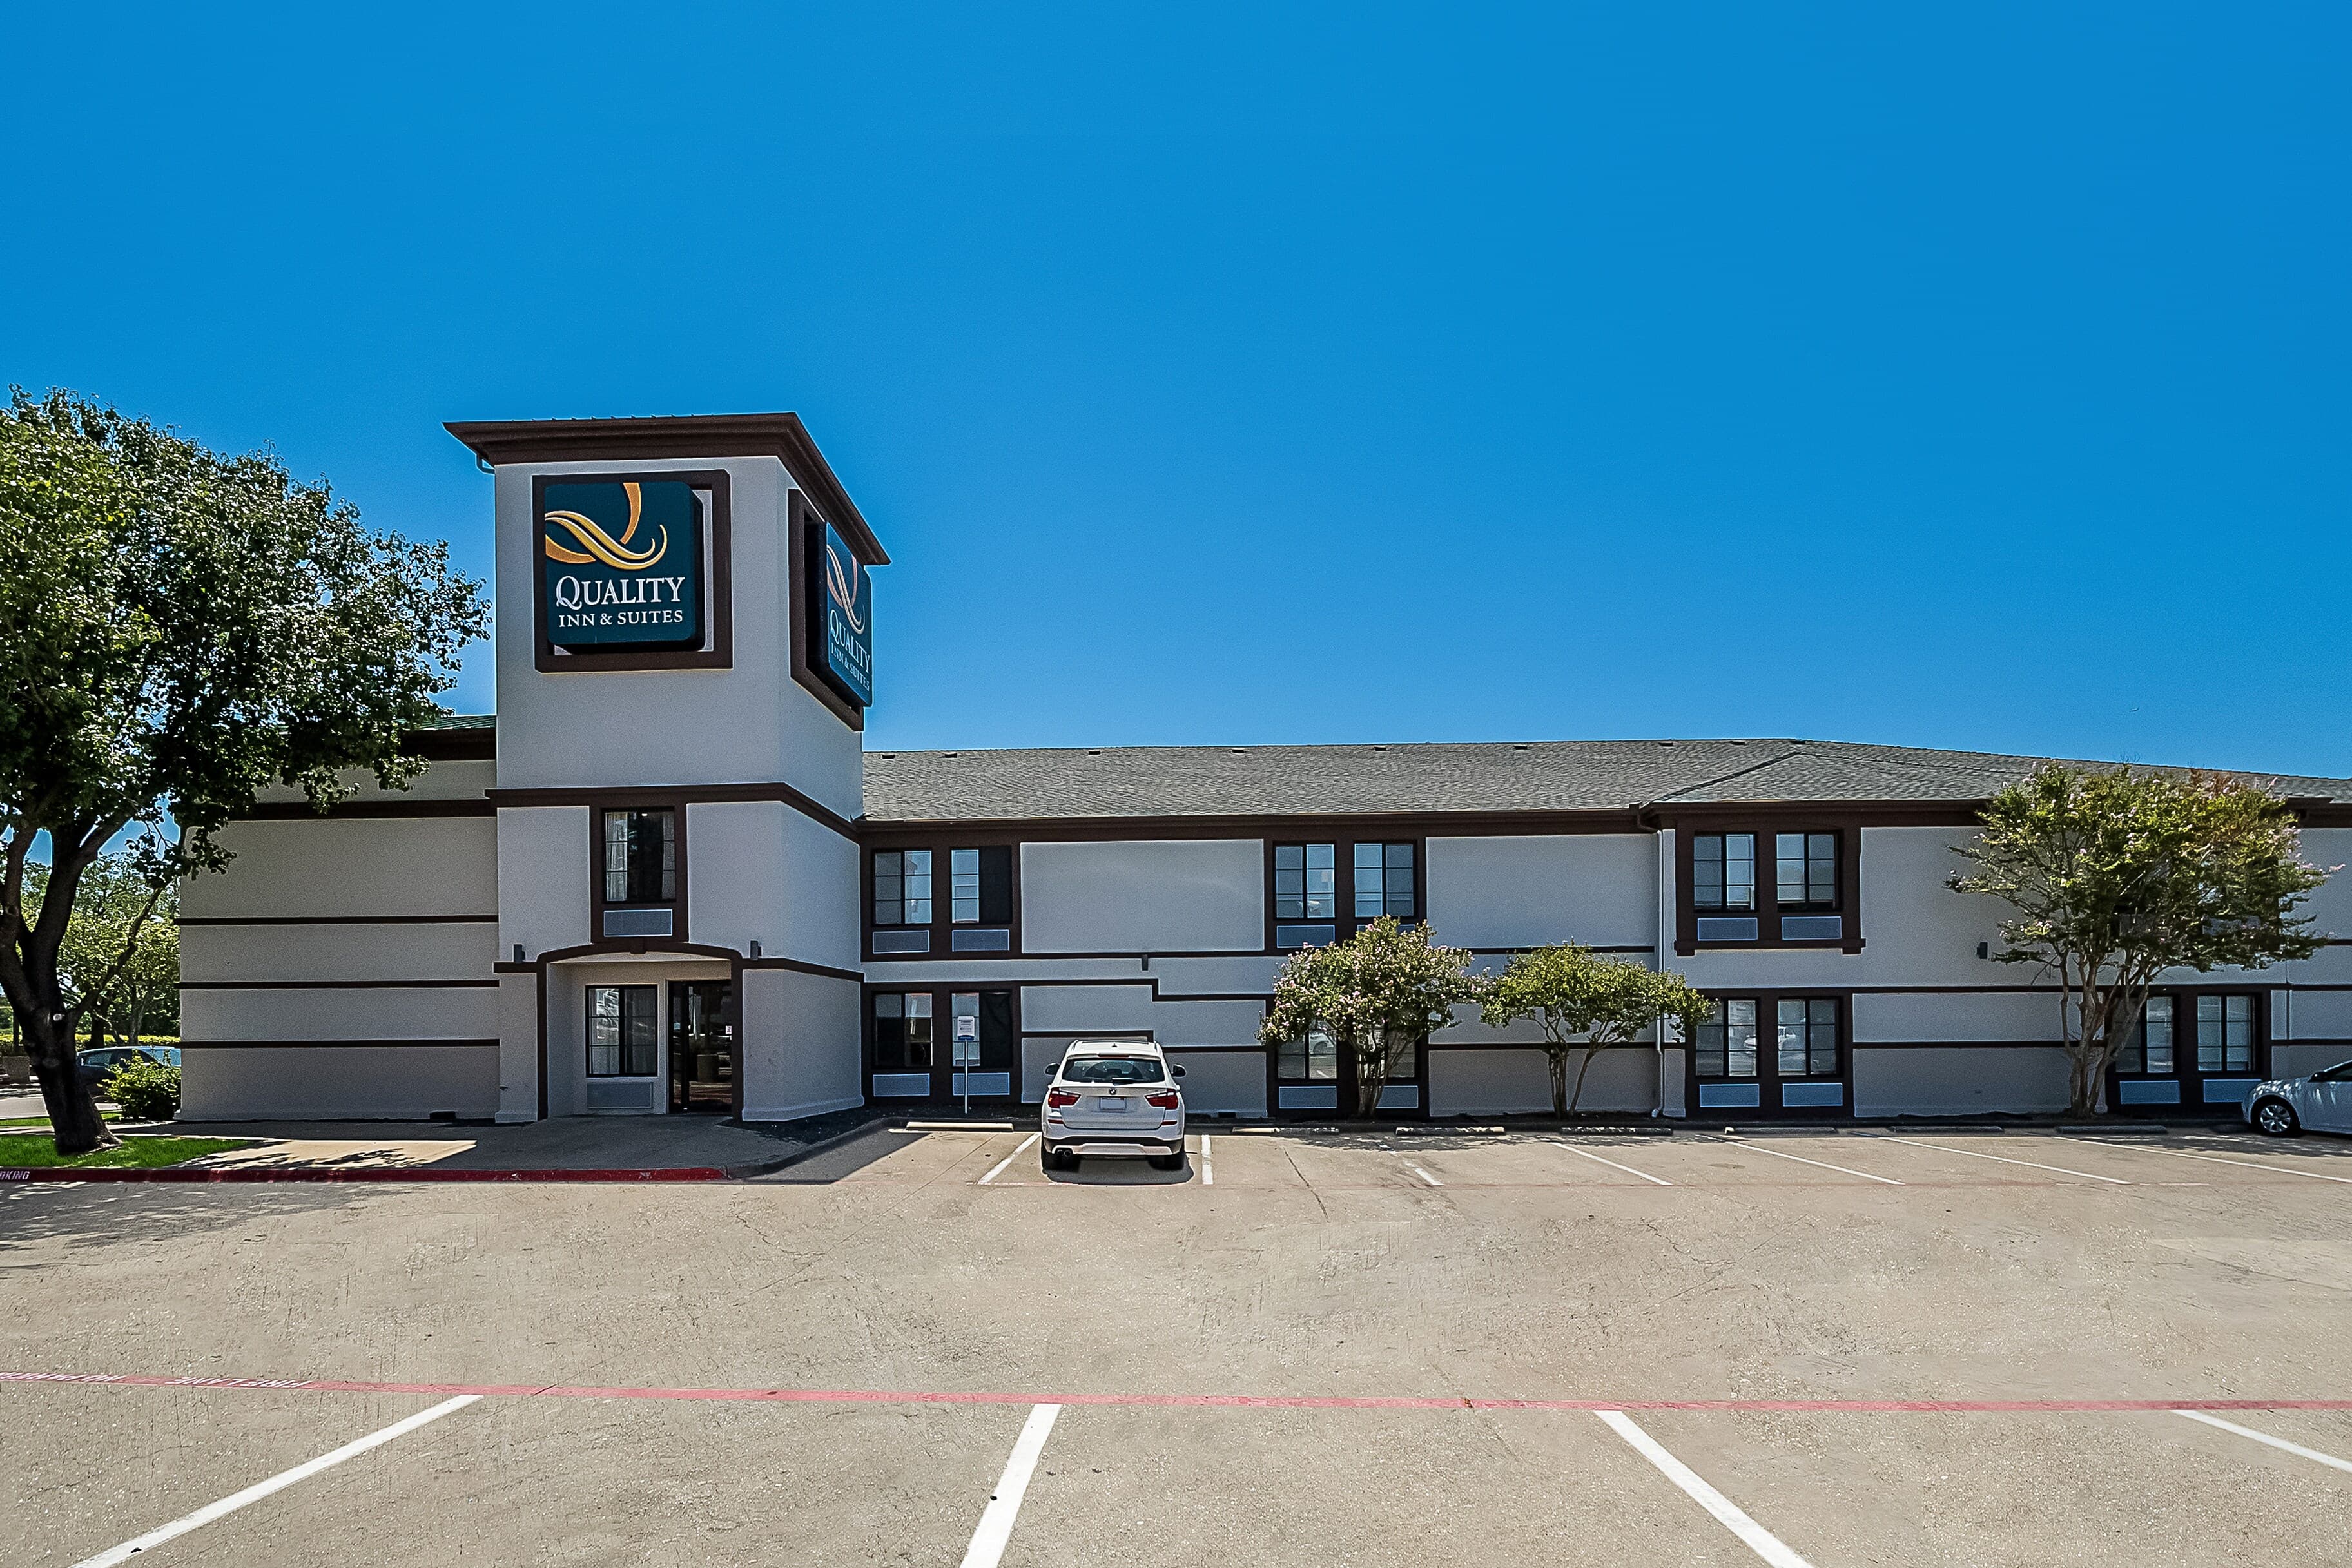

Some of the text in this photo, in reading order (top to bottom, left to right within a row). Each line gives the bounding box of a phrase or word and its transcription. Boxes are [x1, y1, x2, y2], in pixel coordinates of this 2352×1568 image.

[556, 576, 685, 610] QUALITY
[559, 610, 683, 628] INN & SUITES
[830, 609, 870, 673] QUALITY
[831, 643, 844, 664] INN
[850, 663, 870, 692] SUITES
[165, 1377, 249, 1386] LANE
[240, 1379, 313, 1388] FIRE
